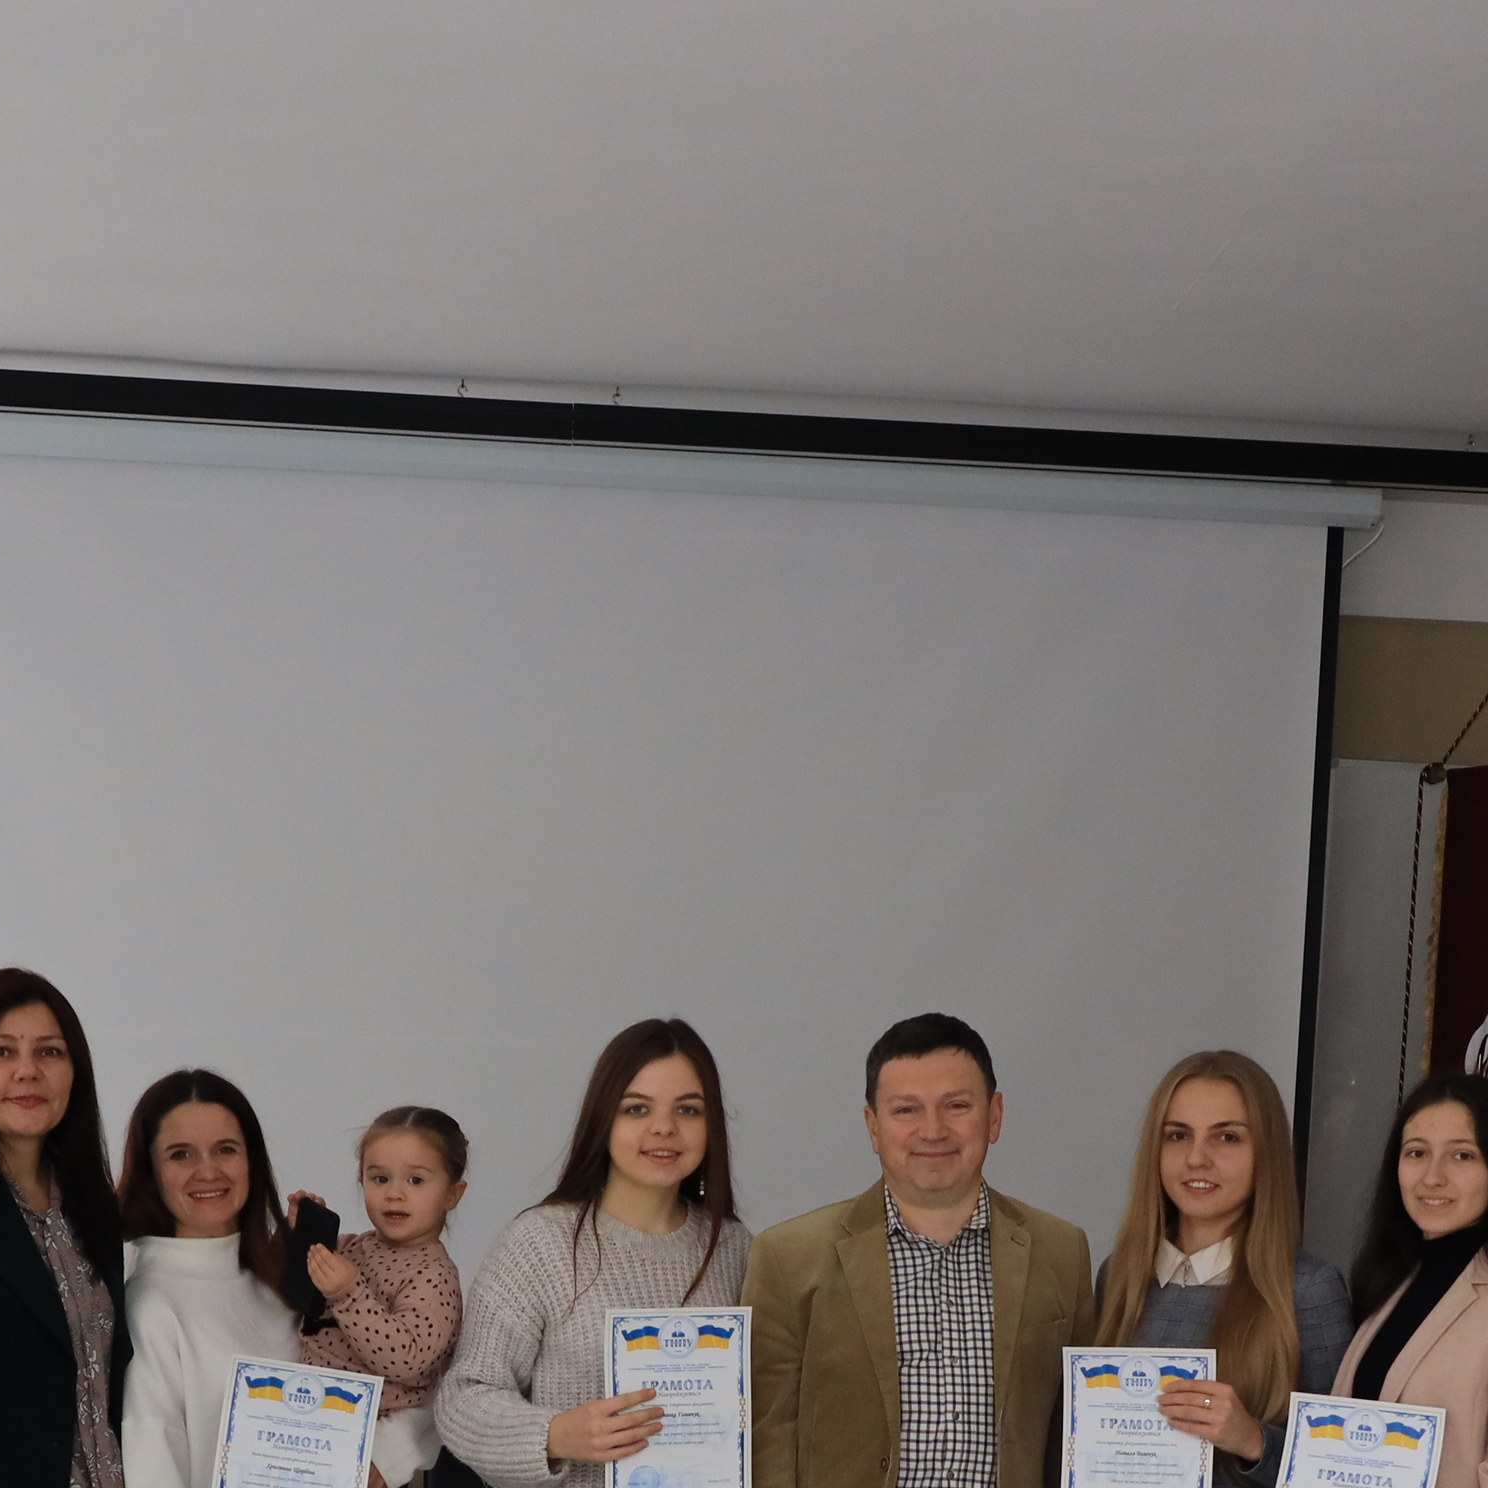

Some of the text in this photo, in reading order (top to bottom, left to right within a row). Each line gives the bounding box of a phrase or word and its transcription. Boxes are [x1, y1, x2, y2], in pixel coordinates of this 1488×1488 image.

[663, 1339, 693, 1349] ТНПУ
[642, 1379, 713, 1391] ГРАМОТА
[1124, 1378, 1155, 1389] ТНПУ
[287, 1393, 318, 1406] ТНПУ
[1100, 1418, 1173, 1431] ГРАМОТА
[257, 1430, 331, 1451] ГРАМОТА
[1349, 1431, 1380, 1444] ТНПУ
[1317, 1469, 1392, 1488] ГРАМОТА
